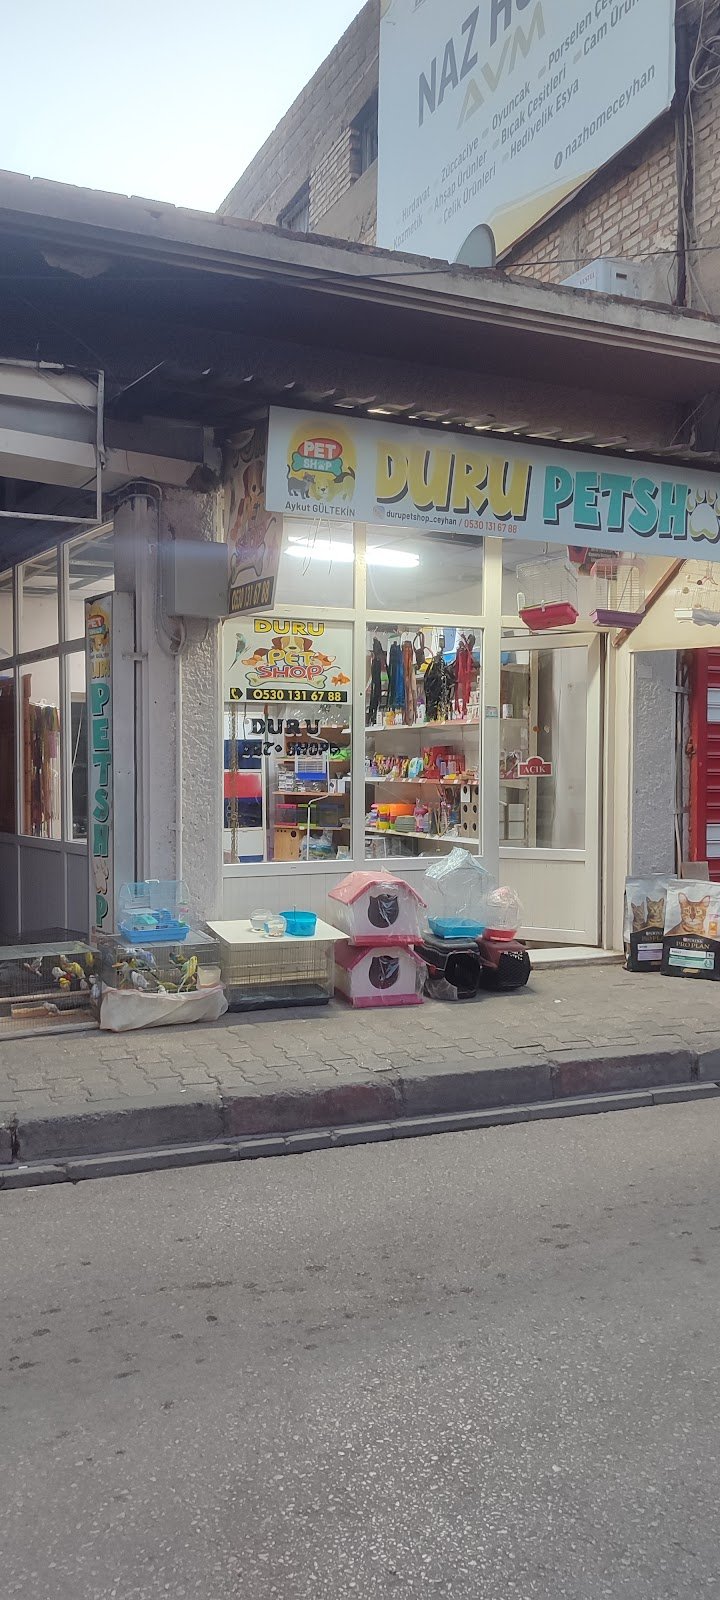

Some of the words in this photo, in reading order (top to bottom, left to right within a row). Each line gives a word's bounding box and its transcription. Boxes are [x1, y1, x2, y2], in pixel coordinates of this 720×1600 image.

[418, 5, 480, 128] NAZ
[457, 1, 546, 131] AVM
[492, 81, 531, 130] Oyuncak
[548, 11, 592, 70] Porselen
[501, 109, 526, 145] Bıçak
[527, 63, 567, 119] Çeşitleri
[583, 22, 607, 56] Cam
[564, 64, 655, 160] nazhomeceyhan
[463, 161, 496, 205] Ürünleri
[509, 104, 554, 159] Hediyelik
[556, 79, 579, 114] Eşya
[303, 440, 337, 460] PET
[375, 438, 533, 522] DURU
[285, 501, 311, 512] Aykut
[312, 502, 356, 517] GÜLTEKİN
[386, 509, 457, 527] durupetshop_ceyhan
[463, 520, 484, 530] 0530
[485, 521, 496, 531] 131
[497, 523, 506, 533] 67
[508, 524, 518, 534] 88
[253, 618, 325, 637] DURU
[267, 648, 316, 667] PET
[258, 664, 324, 681] SHOP
[288, 690, 307, 701] 131
[310, 691, 325, 702] 67
[327, 692, 342, 702] 88
[250, 718, 321, 735] DURU
[691, 942, 710, 950] PLAN
